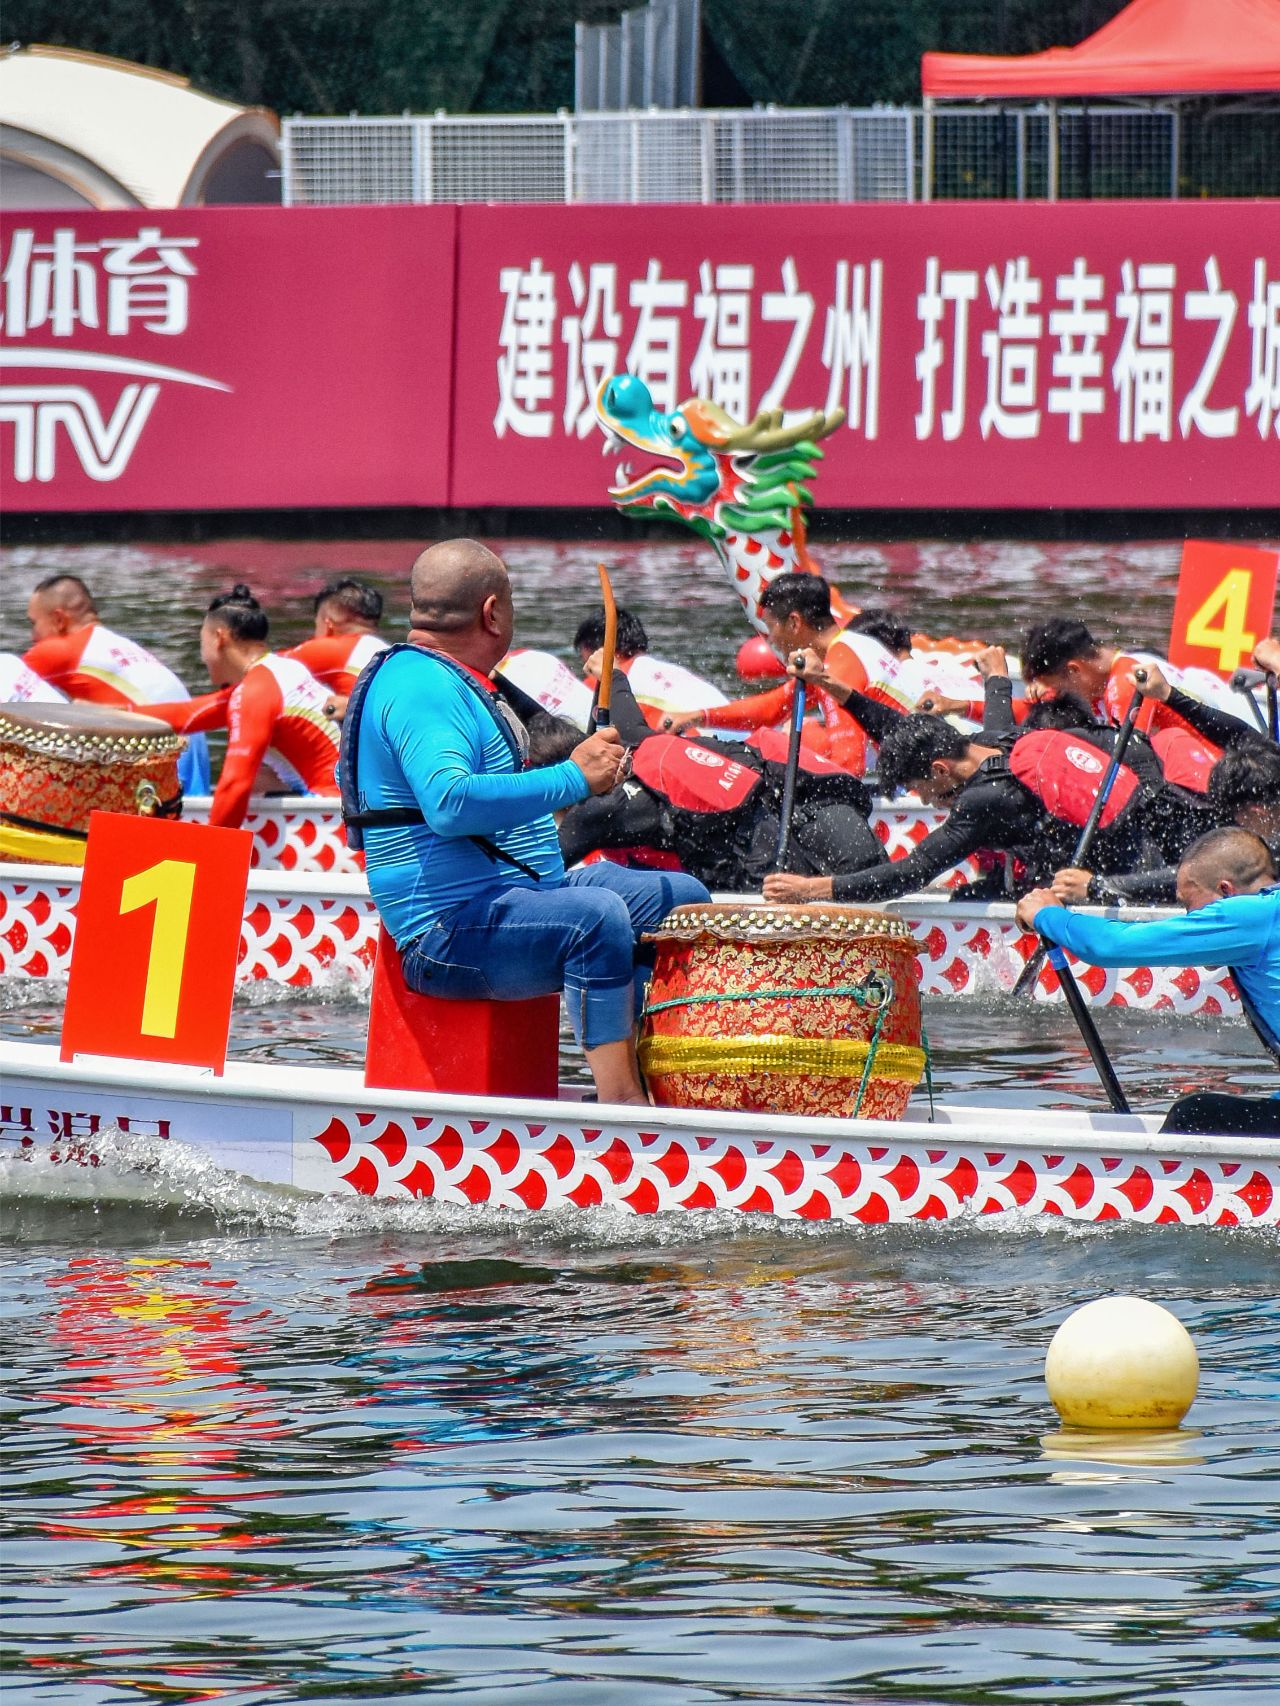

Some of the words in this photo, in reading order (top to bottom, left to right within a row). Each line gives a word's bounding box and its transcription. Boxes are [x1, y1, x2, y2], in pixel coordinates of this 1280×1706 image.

[0, 228, 199, 337] 体育
[493, 256, 883, 441] 建设有福之州
[1185, 568, 1255, 672] 4
[119, 859, 197, 1039] 1
